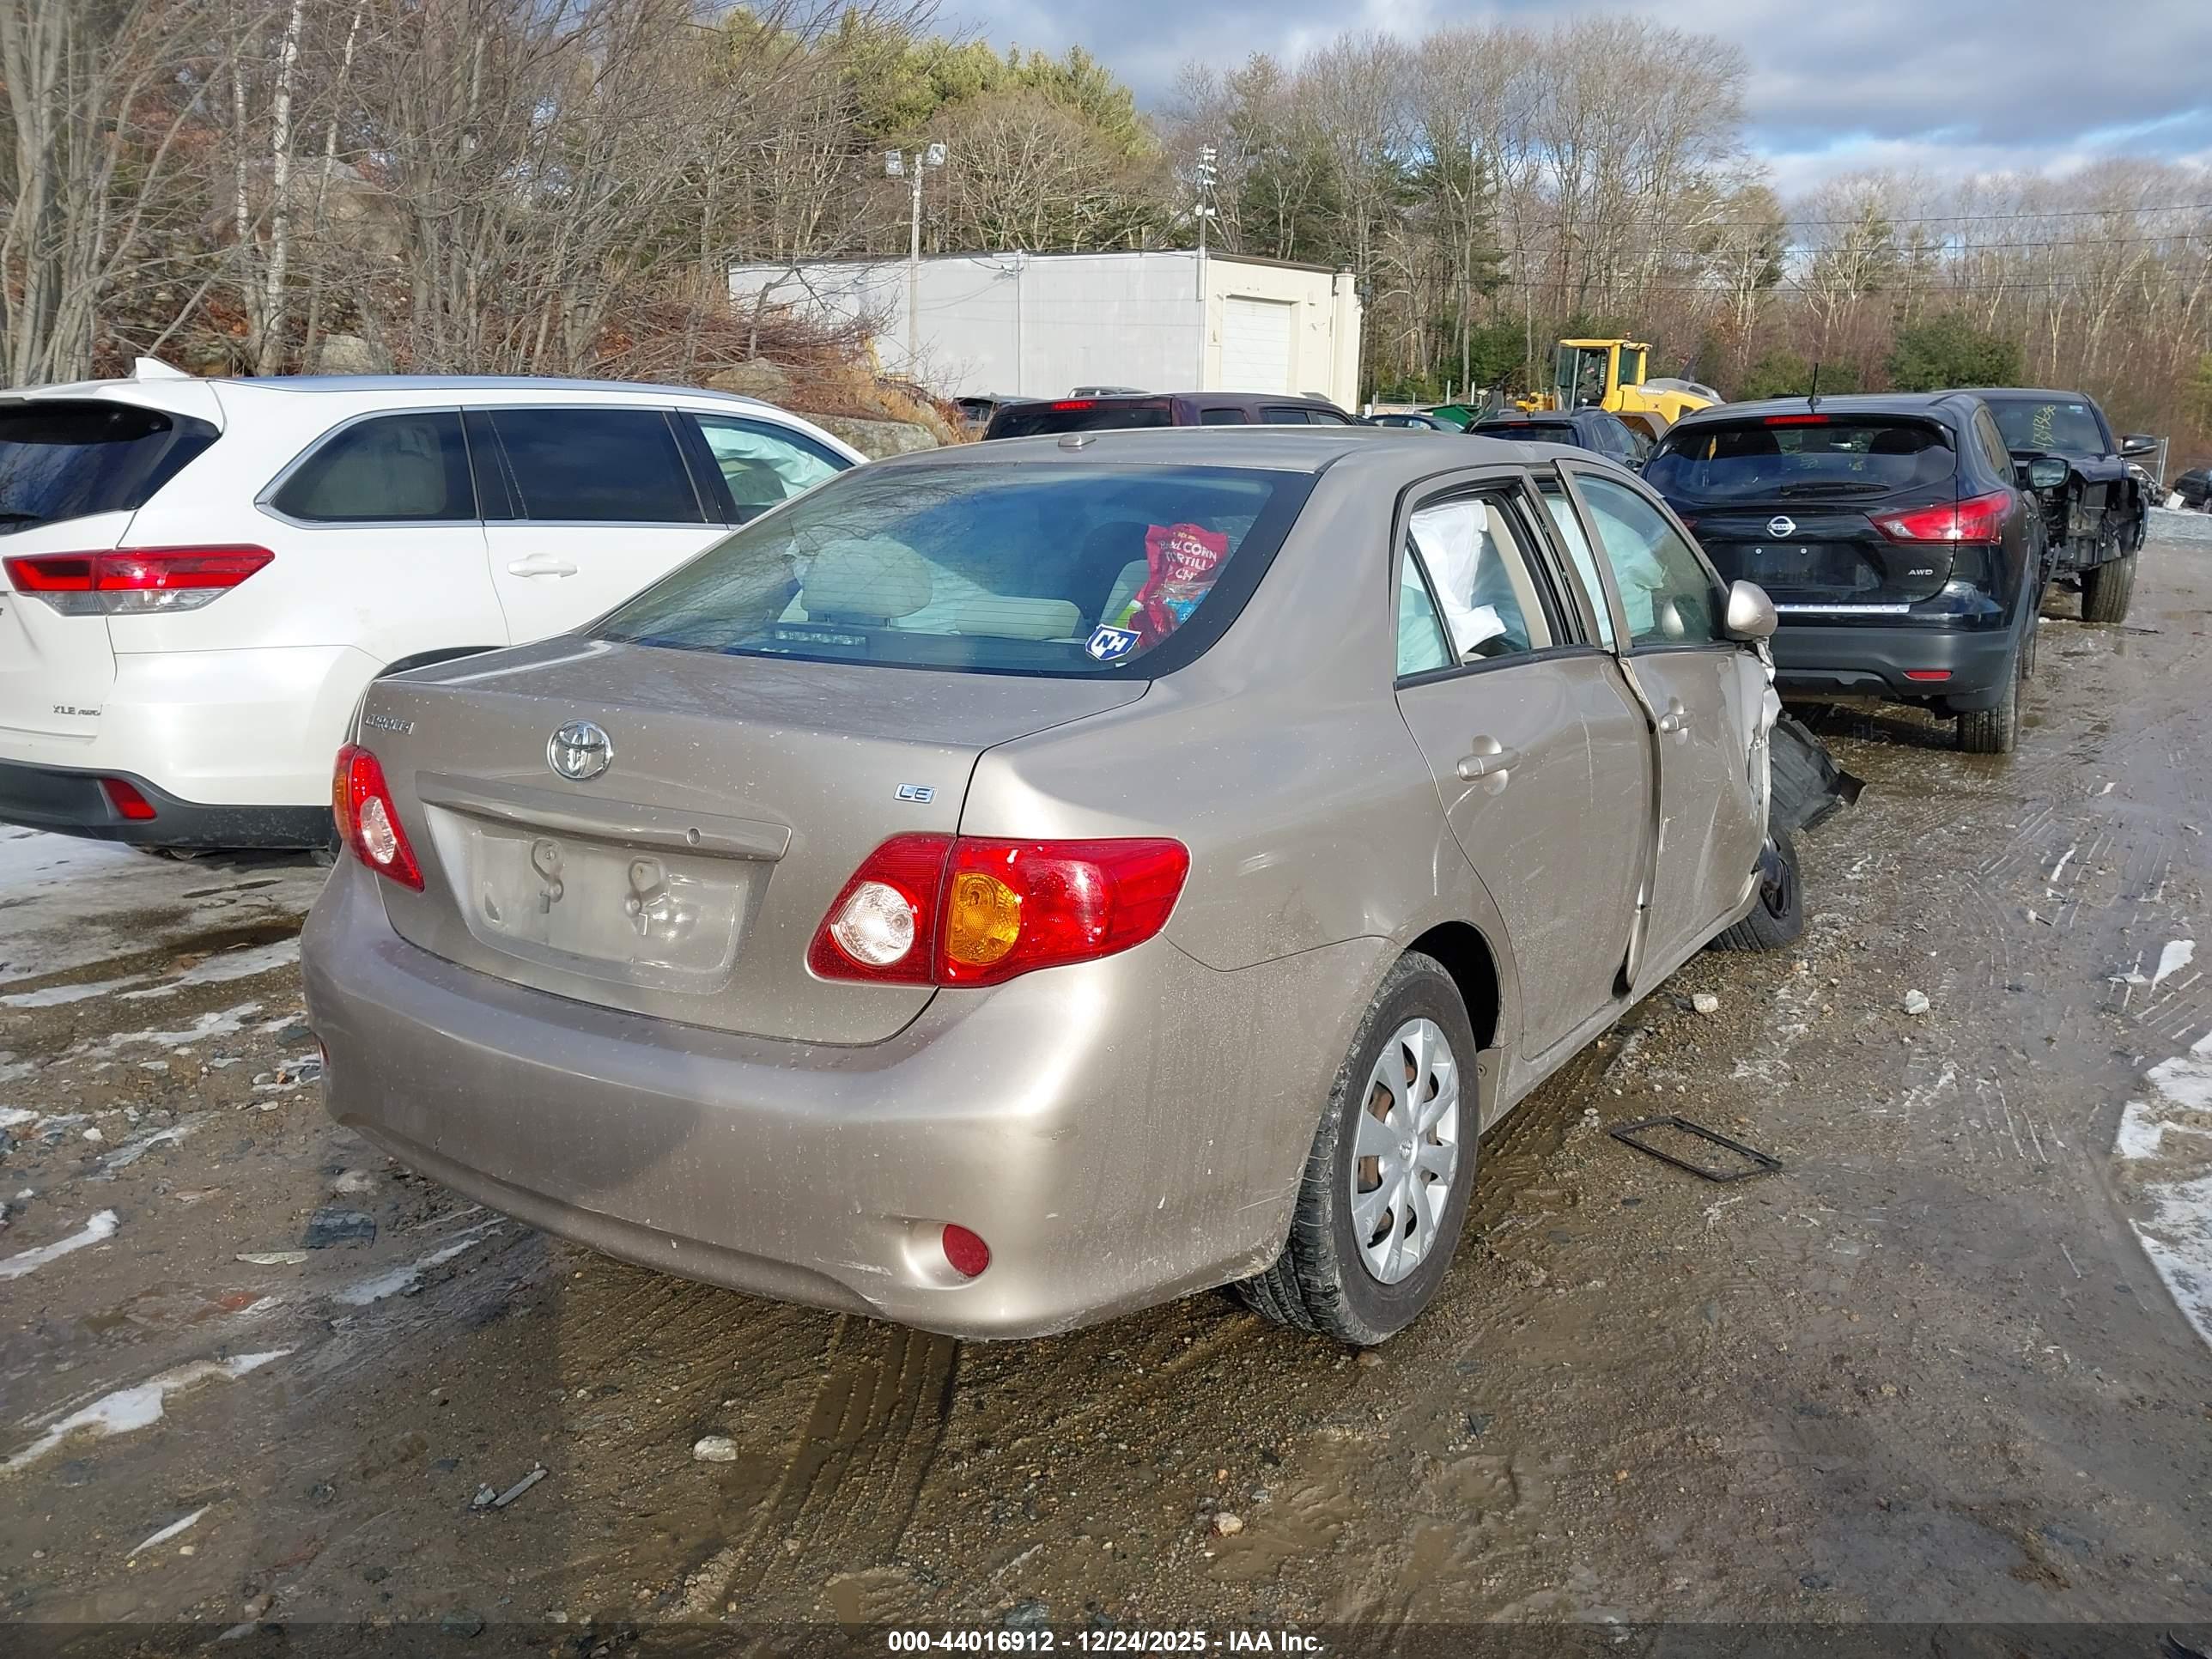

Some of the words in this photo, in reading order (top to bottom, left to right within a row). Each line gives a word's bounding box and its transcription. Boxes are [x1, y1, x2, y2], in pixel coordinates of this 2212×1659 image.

[1182, 541, 1218, 562] CORN
[52, 705, 76, 715] XLE
[899, 785, 931, 800] LE
